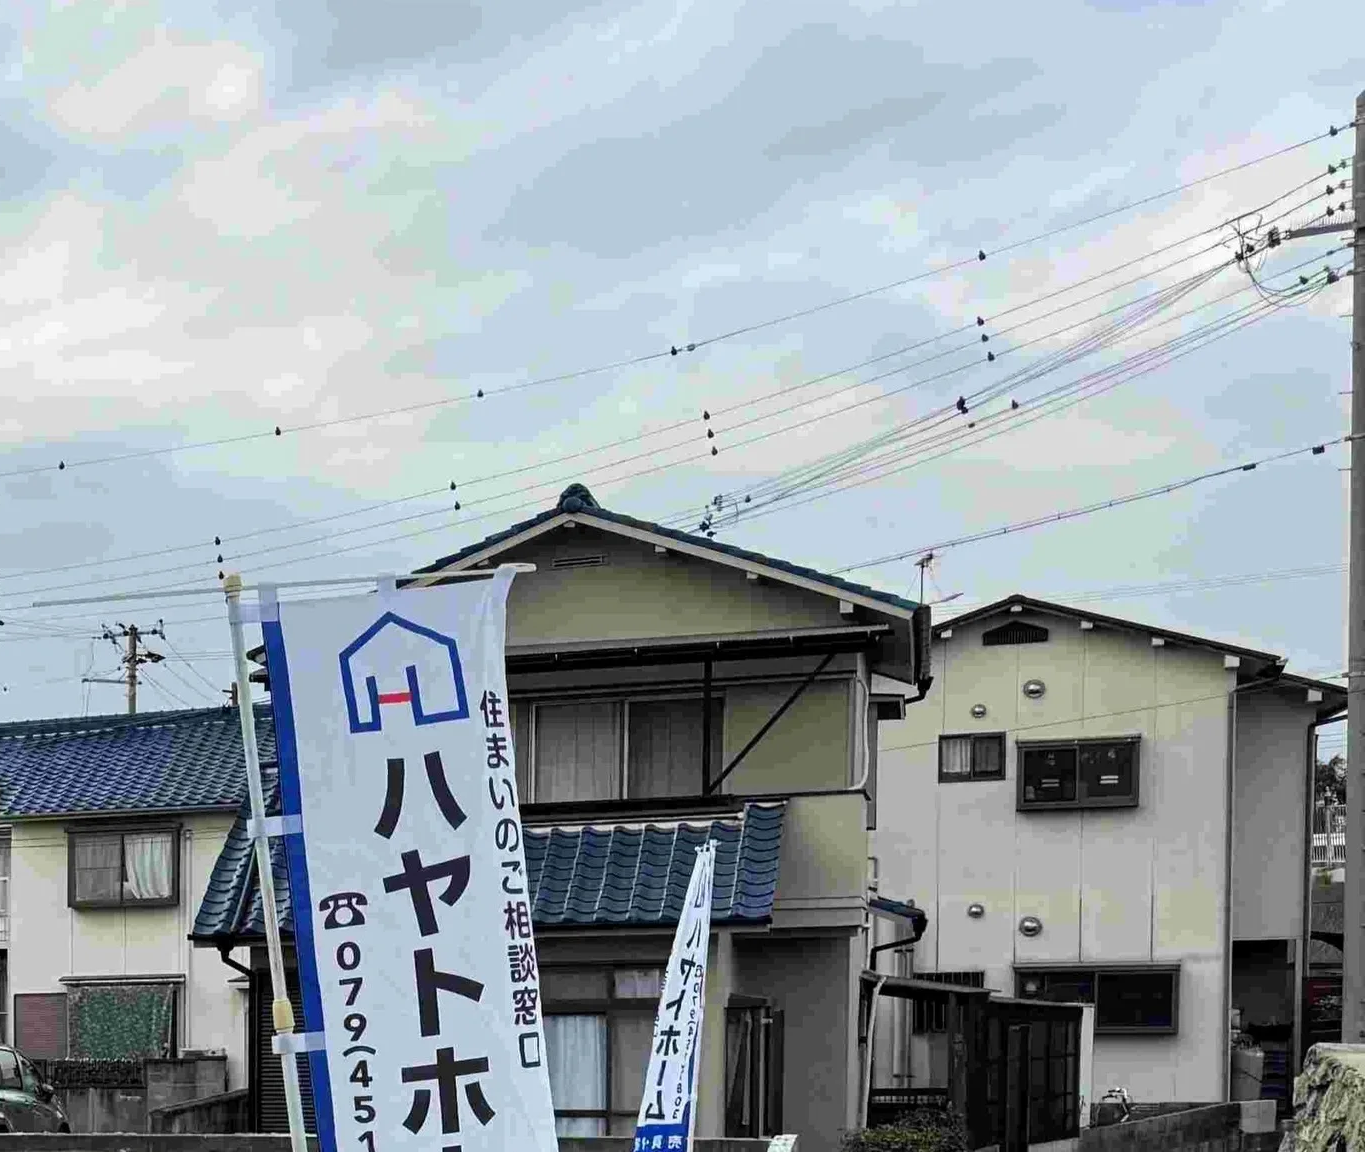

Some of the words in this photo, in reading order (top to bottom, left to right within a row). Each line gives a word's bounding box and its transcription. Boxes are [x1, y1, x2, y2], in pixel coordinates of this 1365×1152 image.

[479, 690, 542, 1069] 住まいのご相談窓口
